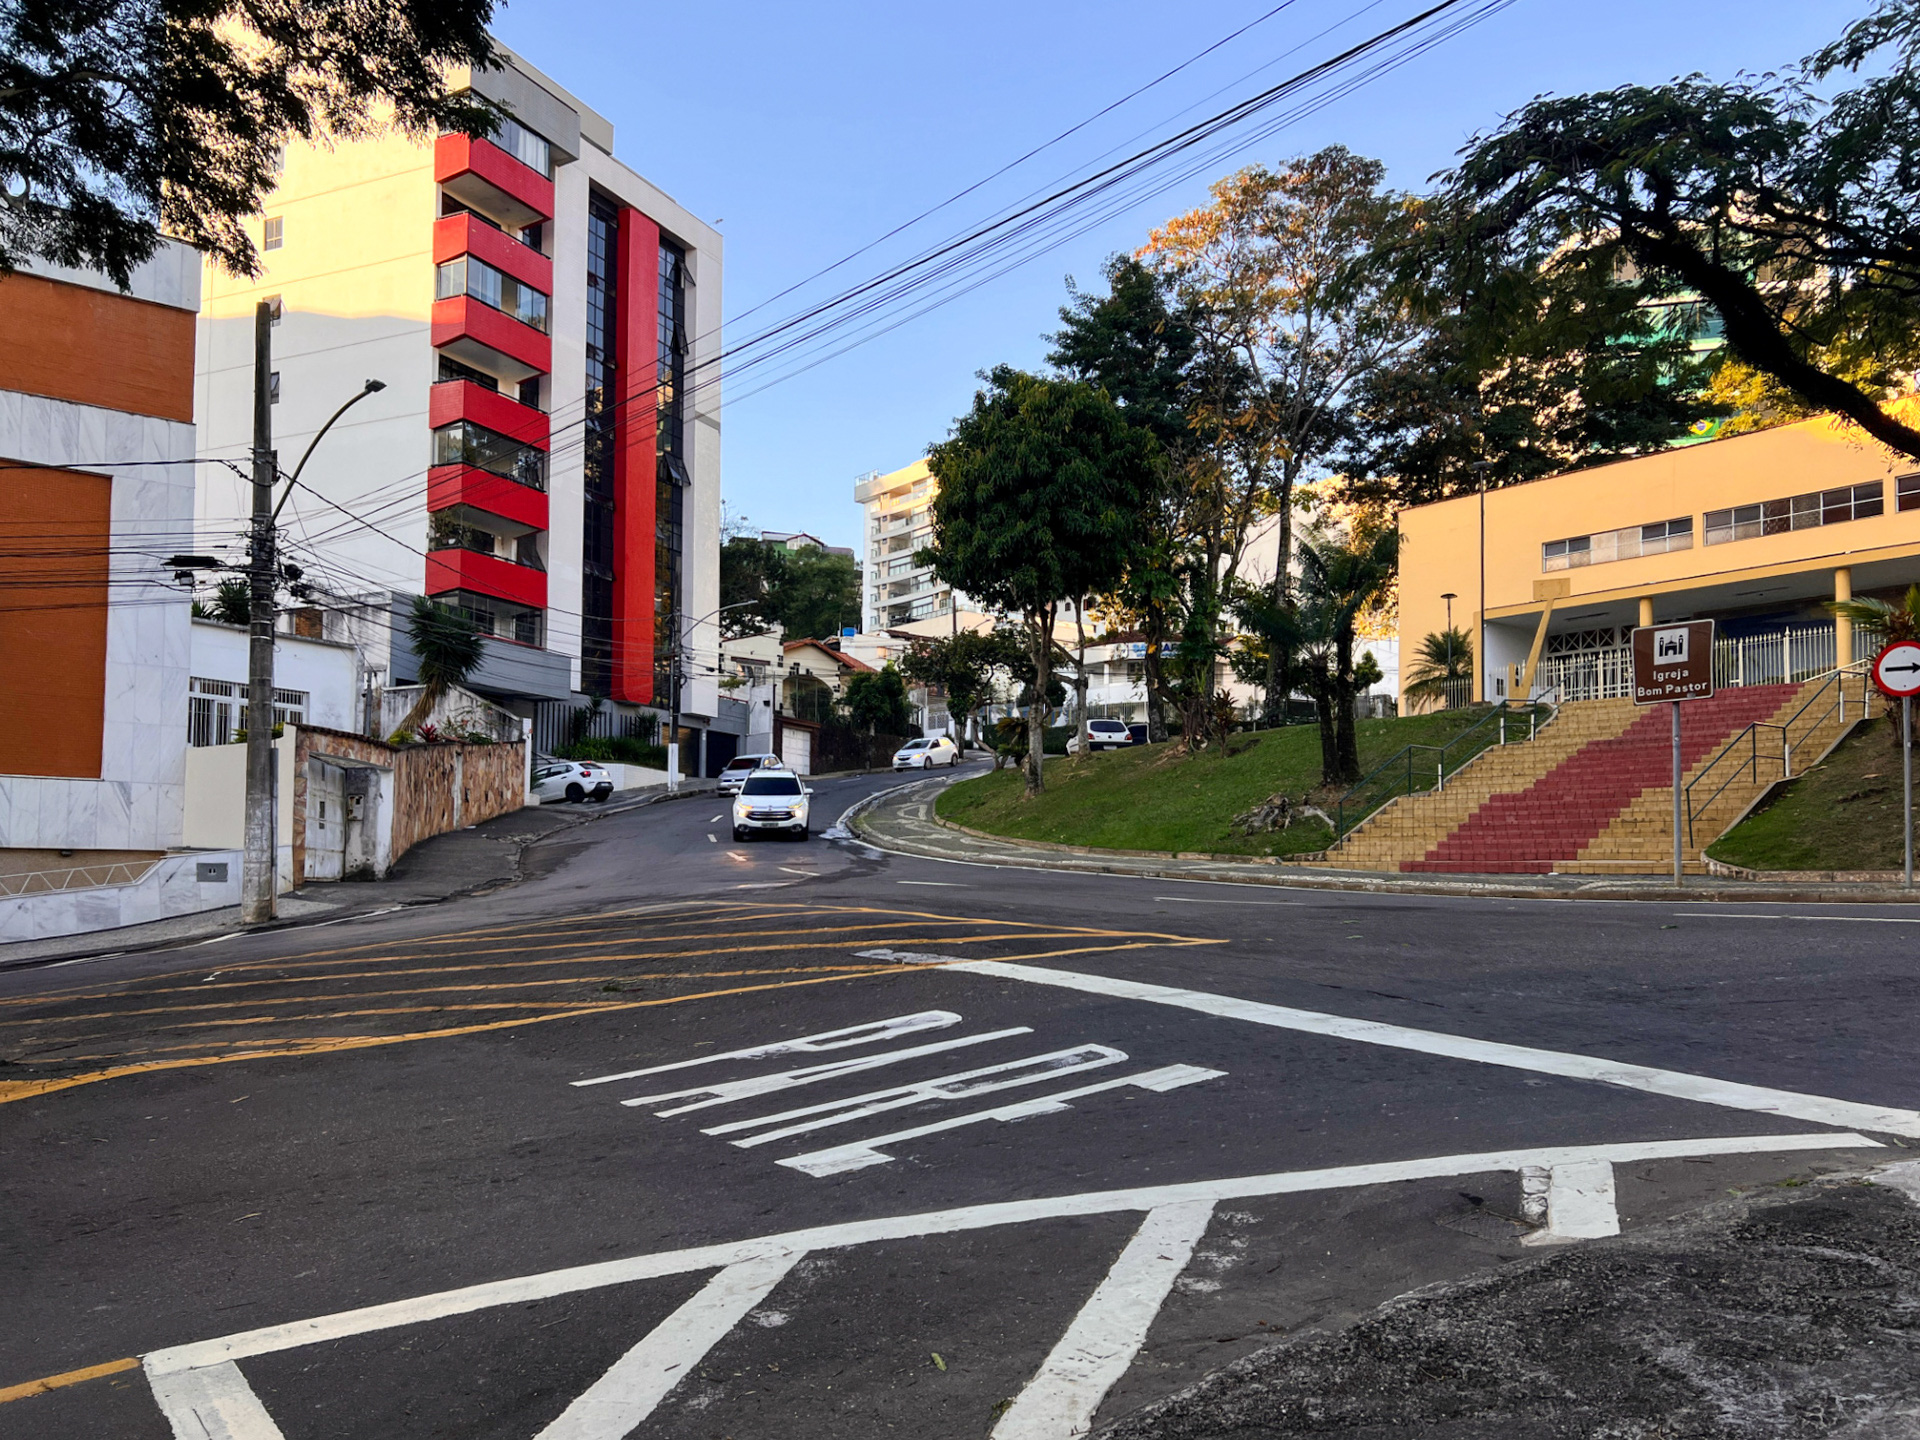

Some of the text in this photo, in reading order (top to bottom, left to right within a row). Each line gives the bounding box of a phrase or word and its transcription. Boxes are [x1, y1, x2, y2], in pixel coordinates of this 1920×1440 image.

[1653, 668, 1689, 682] Igreja
[1637, 682, 1708, 697] Bom Pastor
[568, 1009, 1230, 1179] PARE
